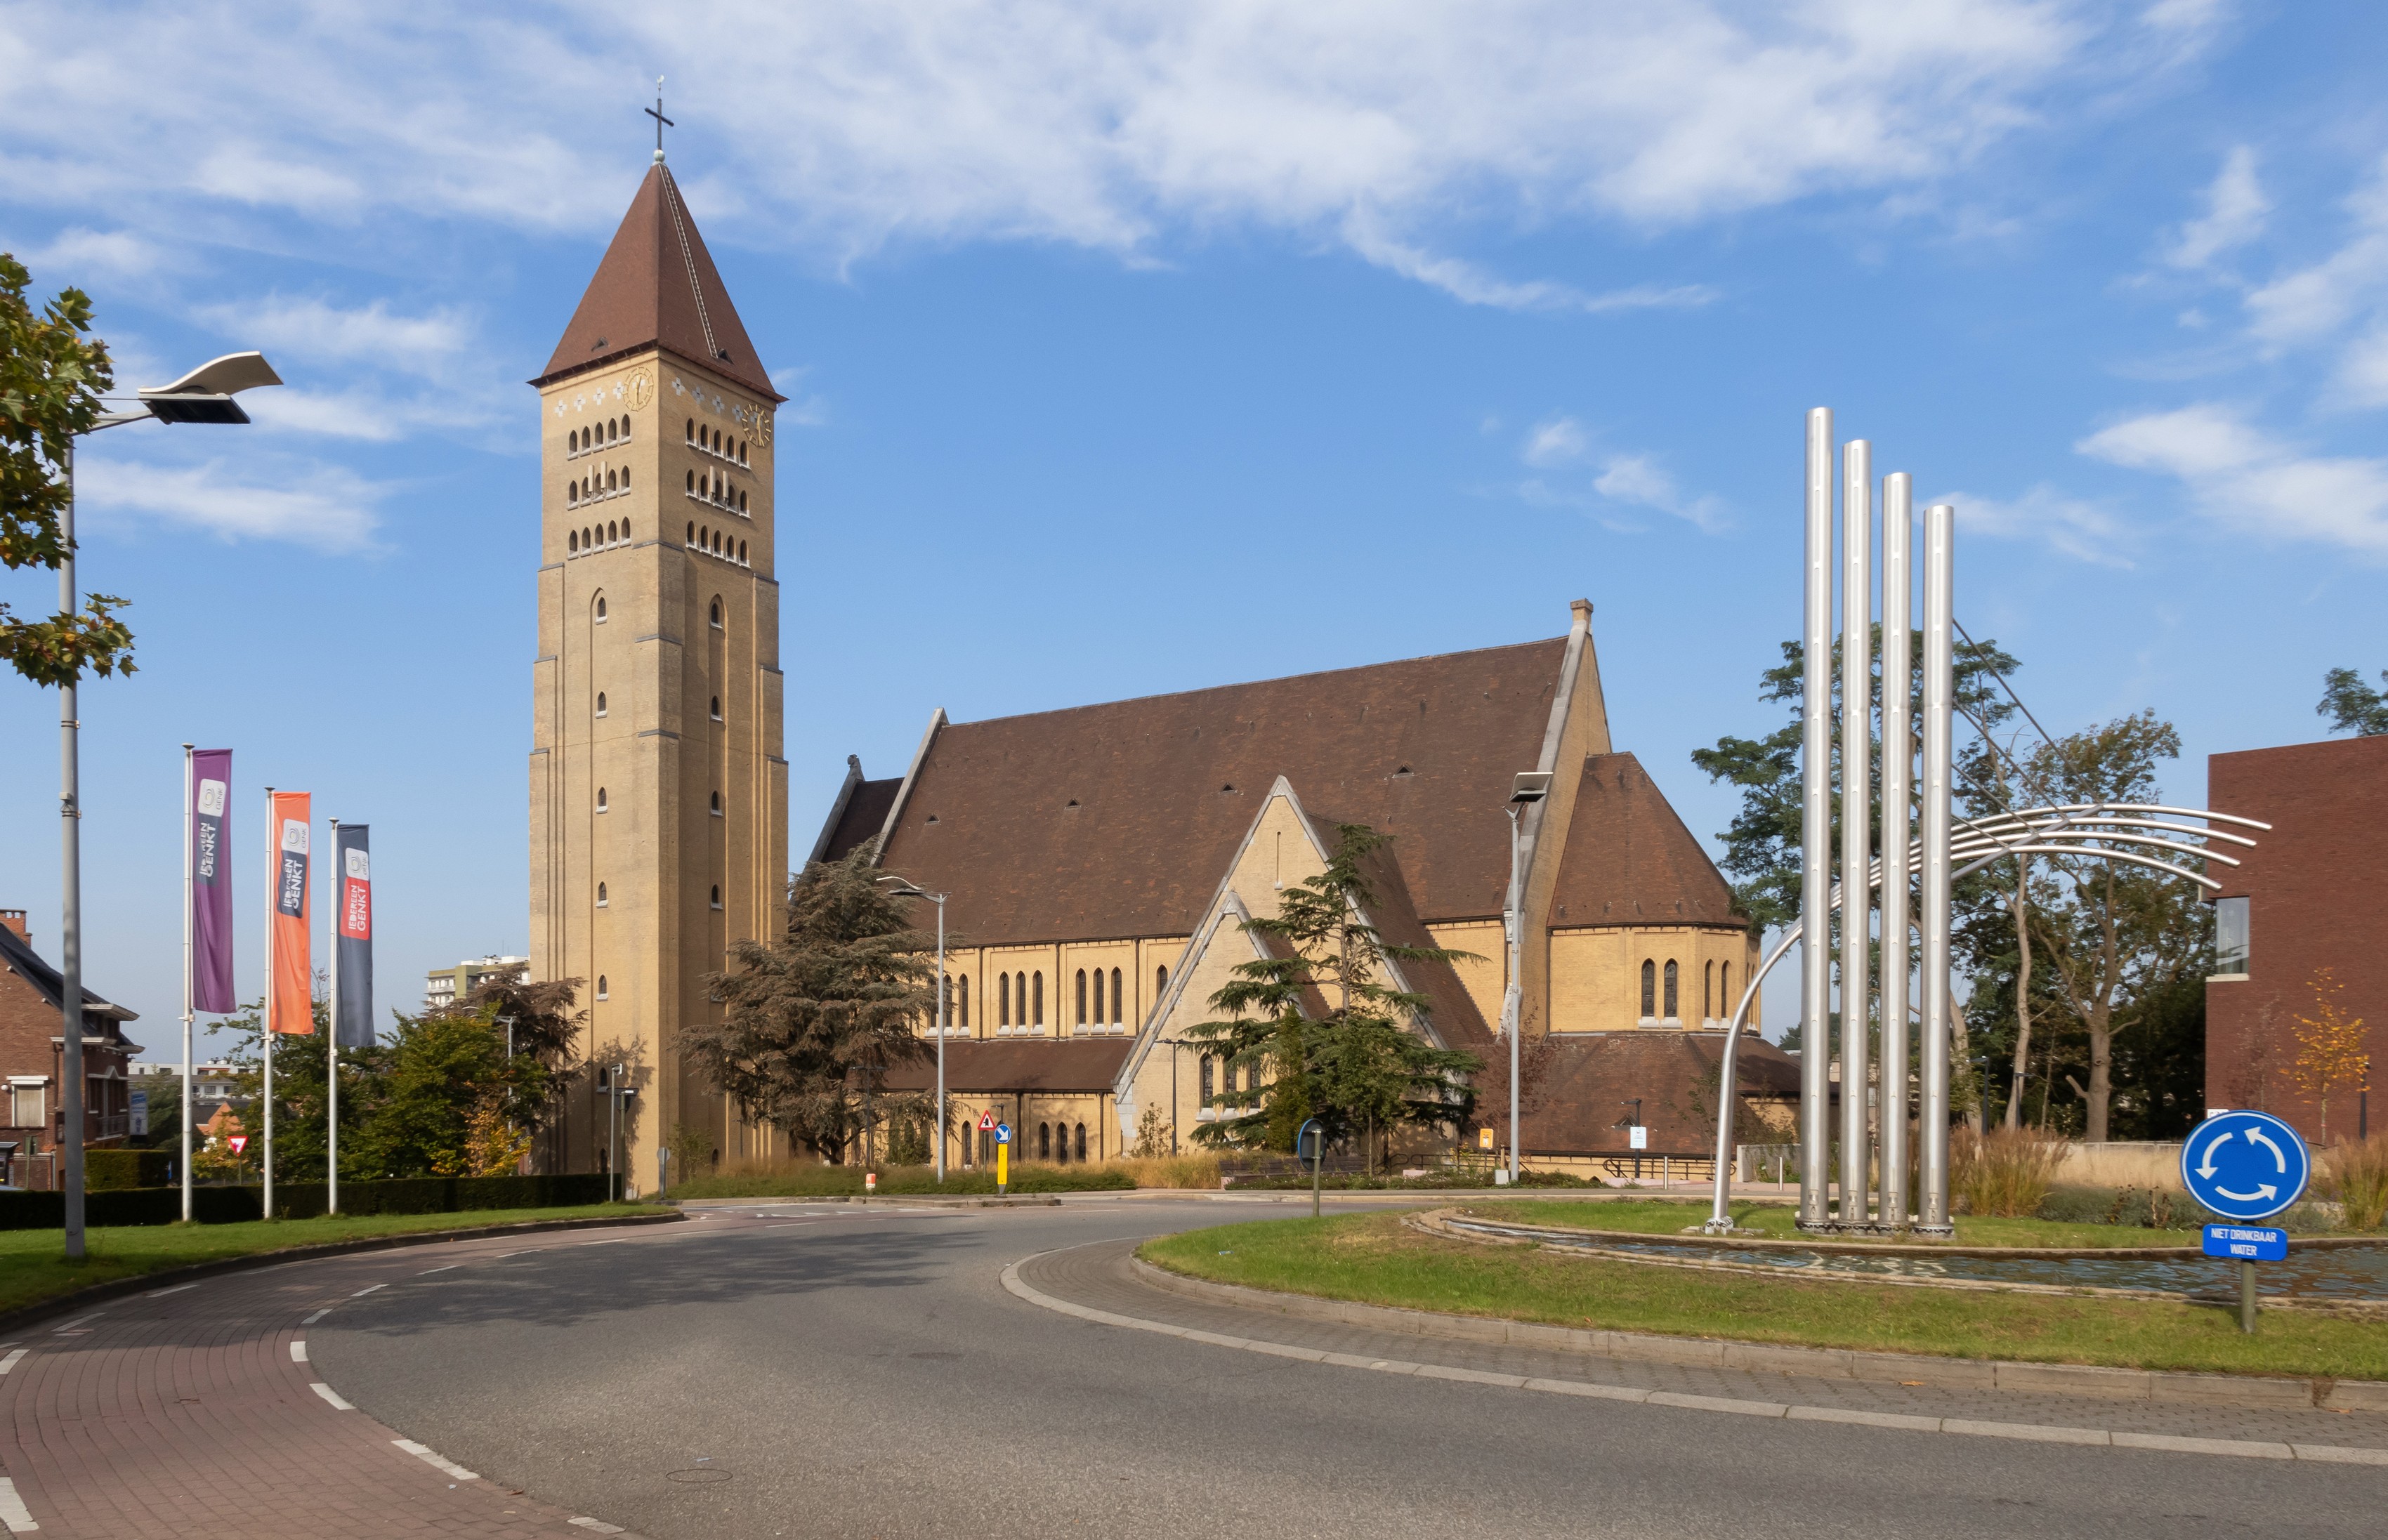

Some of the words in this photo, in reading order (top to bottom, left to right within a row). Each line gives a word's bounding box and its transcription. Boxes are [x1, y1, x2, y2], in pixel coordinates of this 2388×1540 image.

[199, 822, 209, 876] IEDEEN
[205, 824, 216, 877] GENKT
[291, 860, 303, 909] GENKT
[348, 885, 357, 930] IEDEREEN
[357, 886, 366, 931] GENKT
[2211, 1228, 2229, 1239] NIET
[2230, 1229, 2277, 1243] DRINKBAAR
[2230, 1244, 2257, 1256] WATER
